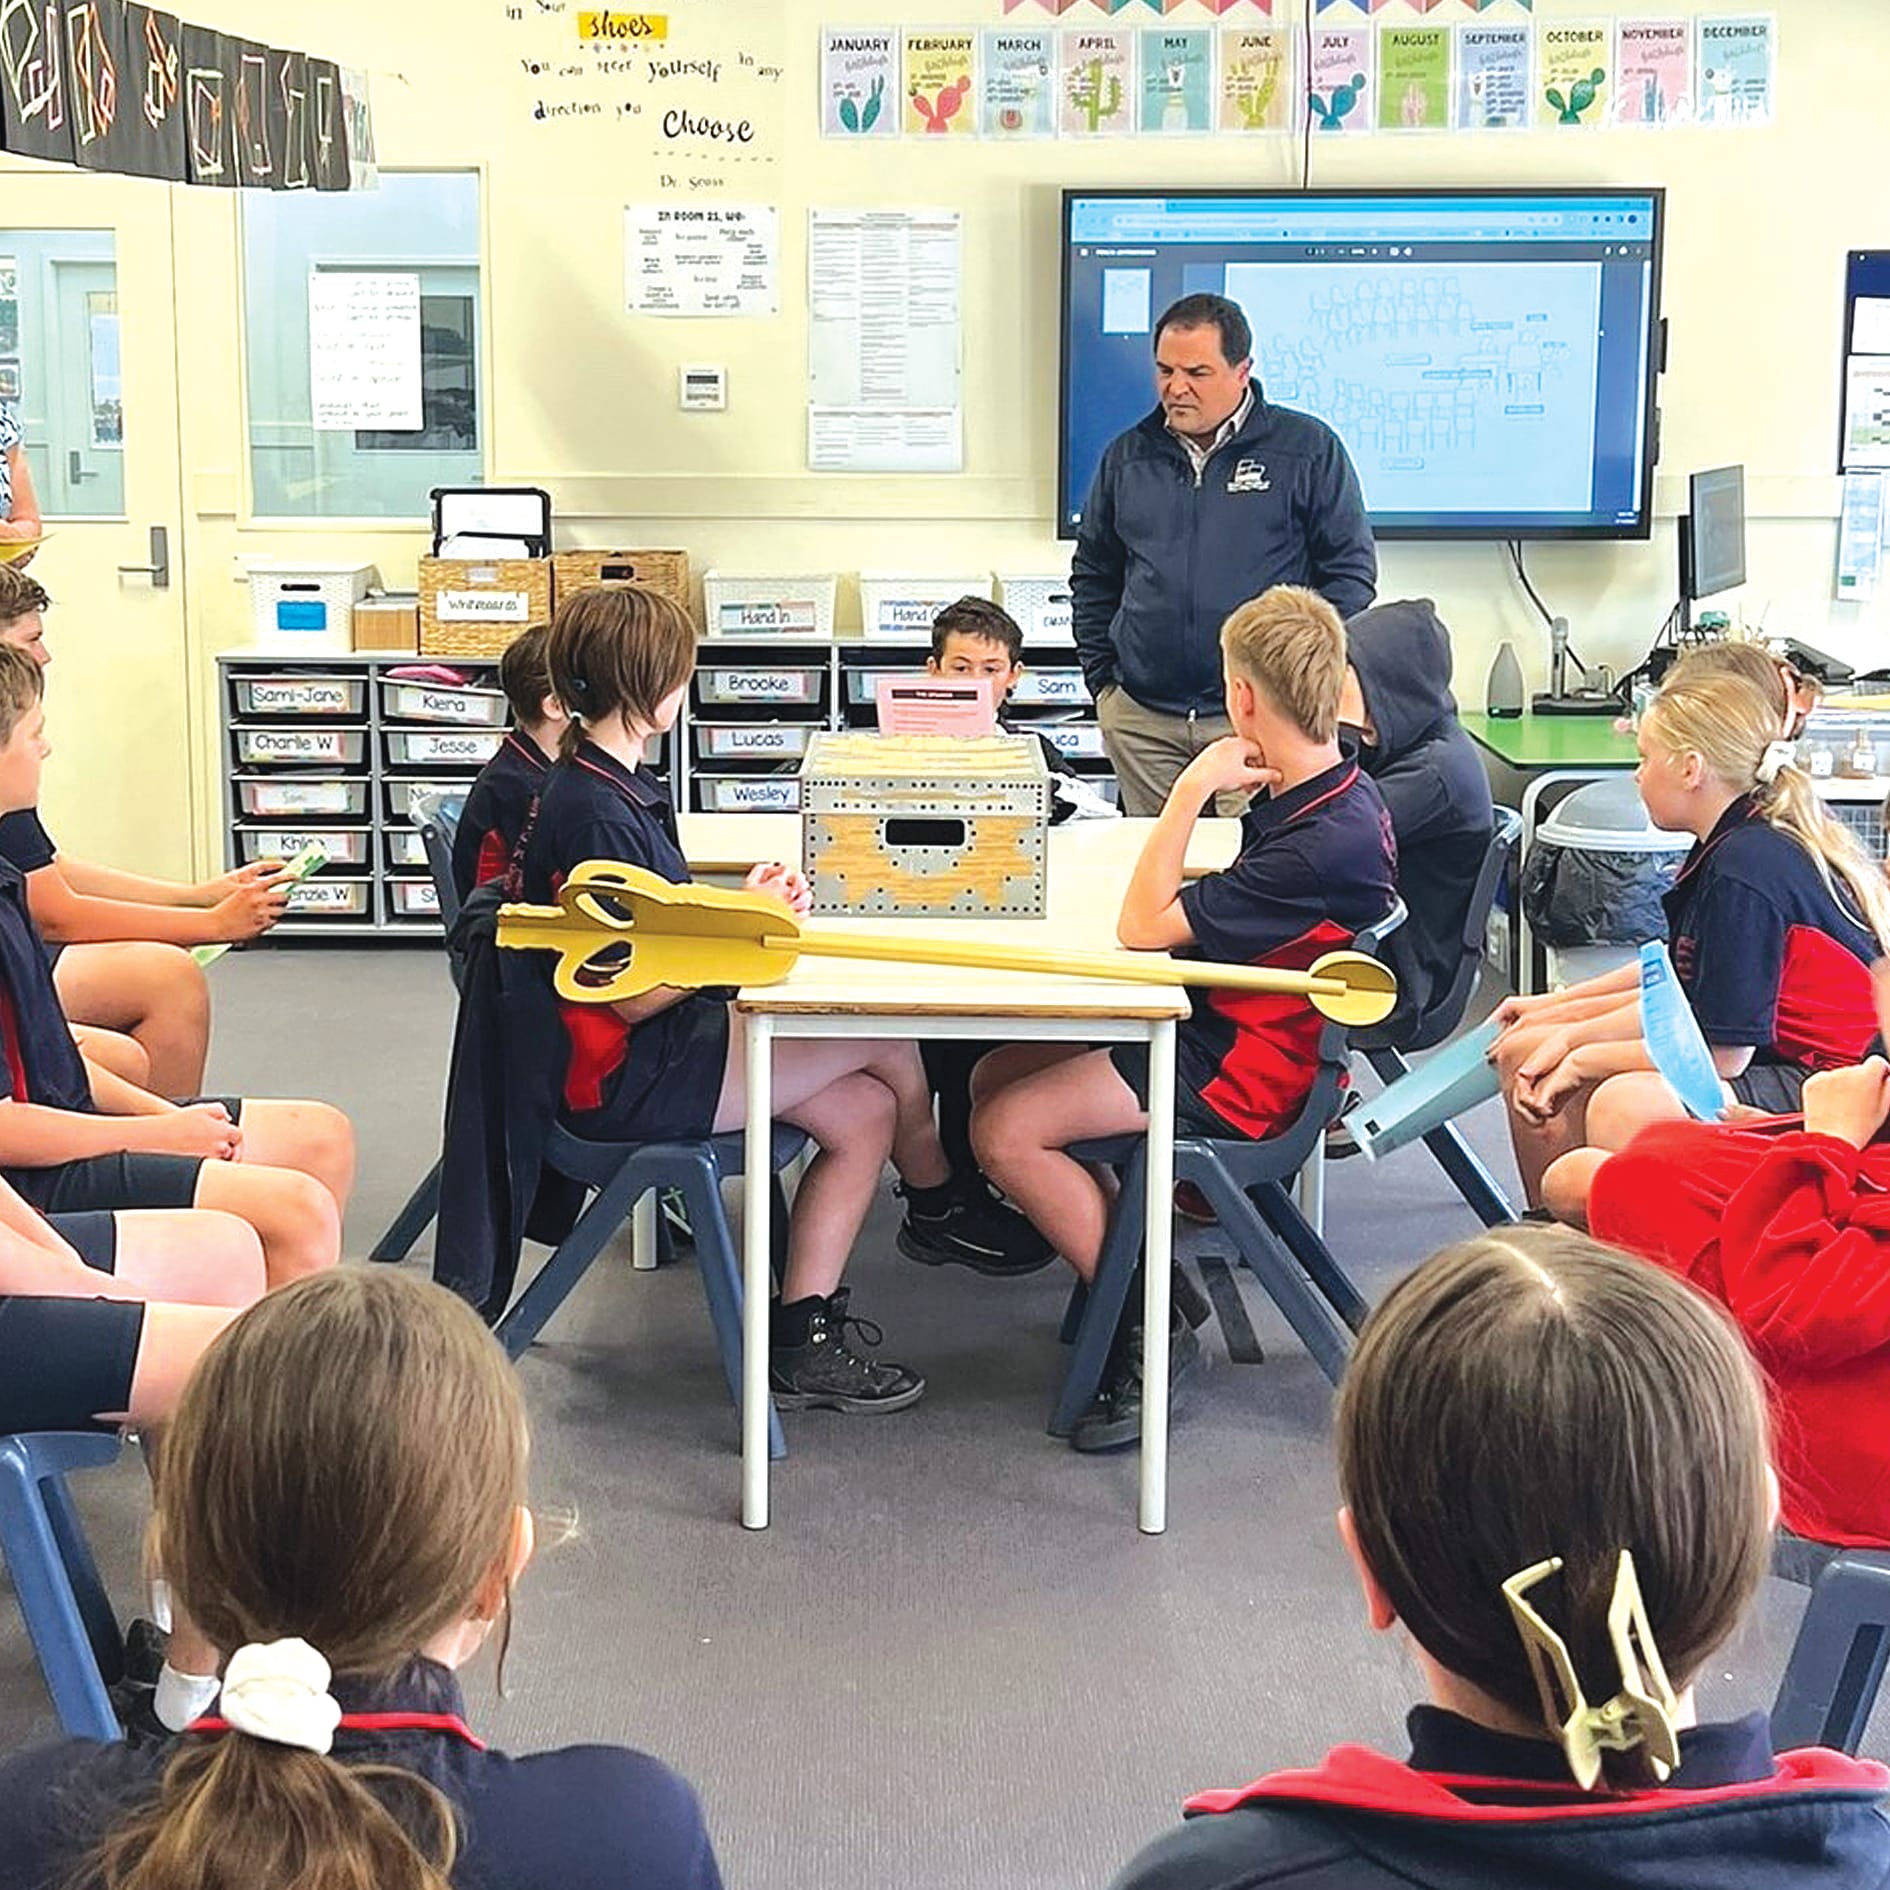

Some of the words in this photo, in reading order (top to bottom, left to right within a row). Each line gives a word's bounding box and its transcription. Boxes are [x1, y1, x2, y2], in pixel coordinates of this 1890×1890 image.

[591, 9, 653, 39] shoes
[1391, 33, 1440, 46] AUGUST
[1464, 33, 1526, 45] SEPTEMBER
[1546, 30, 1604, 43] OCTOBER
[1621, 28, 1684, 40] NOVEMBER
[1703, 25, 1767, 39] DECEMBER
[829, 38, 891, 51] JANUARY
[907, 38, 973, 51] FEBRUARY
[997, 38, 1042, 51] MARCH
[1078, 37, 1117, 50] APRIL
[1164, 37, 1189, 49] MAY
[1240, 35, 1272, 48] JUNE
[1321, 35, 1350, 48] JULY
[648, 58, 722, 84] yourself
[757, 65, 784, 83] any
[534, 99, 601, 120] direction
[615, 102, 642, 122] you
[663, 109, 755, 142] Choose
[740, 606, 776, 625] Hand
[892, 606, 927, 623] Hand
[728, 675, 789, 692] Brooke
[1037, 678, 1077, 695] Sam
[253, 686, 343, 703] Sami-Jane
[422, 694, 467, 713] Kiera
[254, 734, 312, 750] Charlie
[316, 736, 333, 750] W
[429, 737, 478, 754] Jesse
[732, 732, 784, 747] Lucas
[733, 786, 790, 804] Wesley
[332, 886, 350, 901] W
